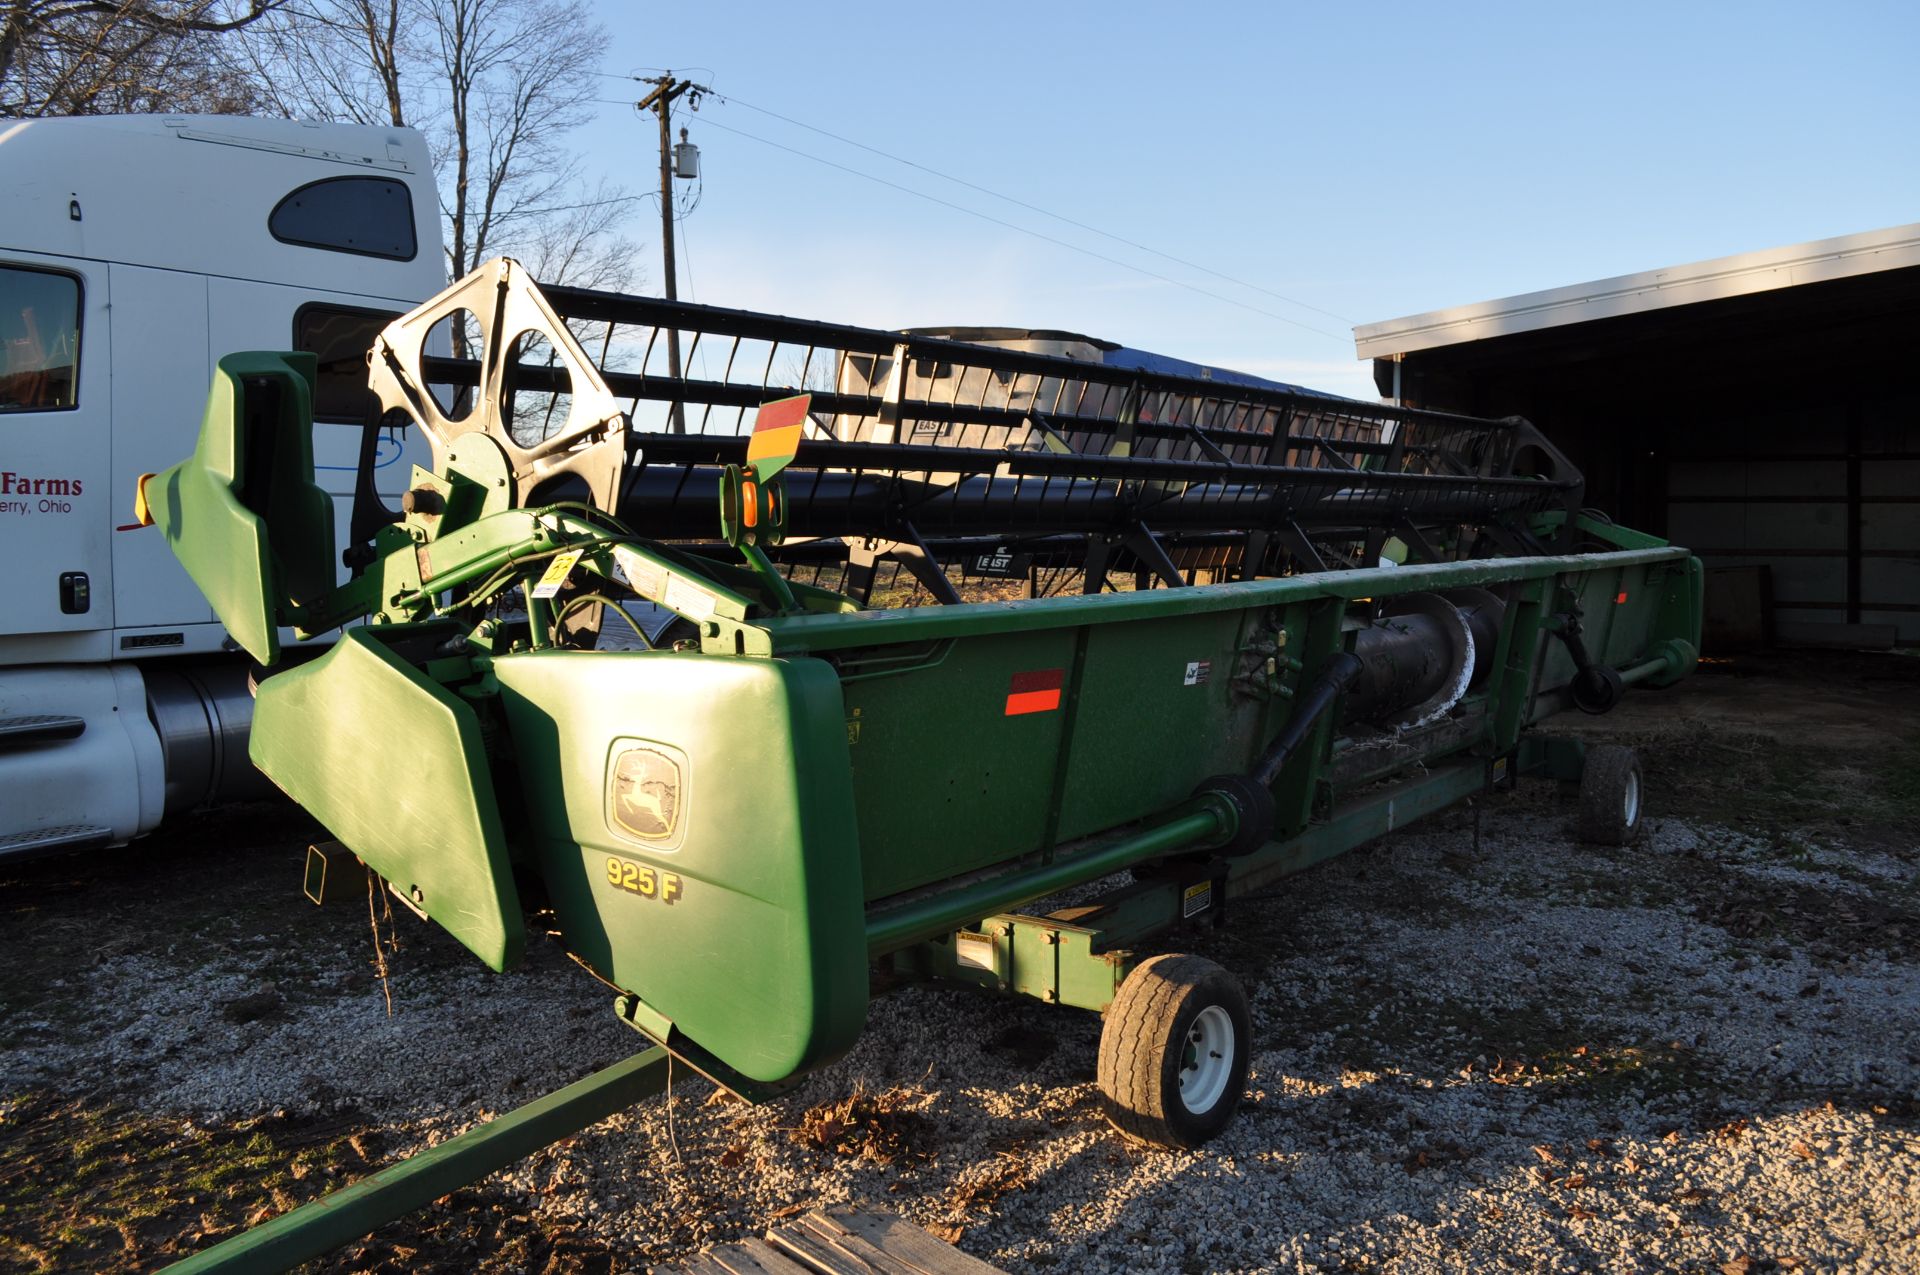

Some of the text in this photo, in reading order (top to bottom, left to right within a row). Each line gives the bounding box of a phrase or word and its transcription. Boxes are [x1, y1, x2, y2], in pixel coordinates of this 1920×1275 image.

[1, 472, 83, 496] Farms
[38, 499, 72, 513] Ohio
[606, 857, 681, 903] 925 F
